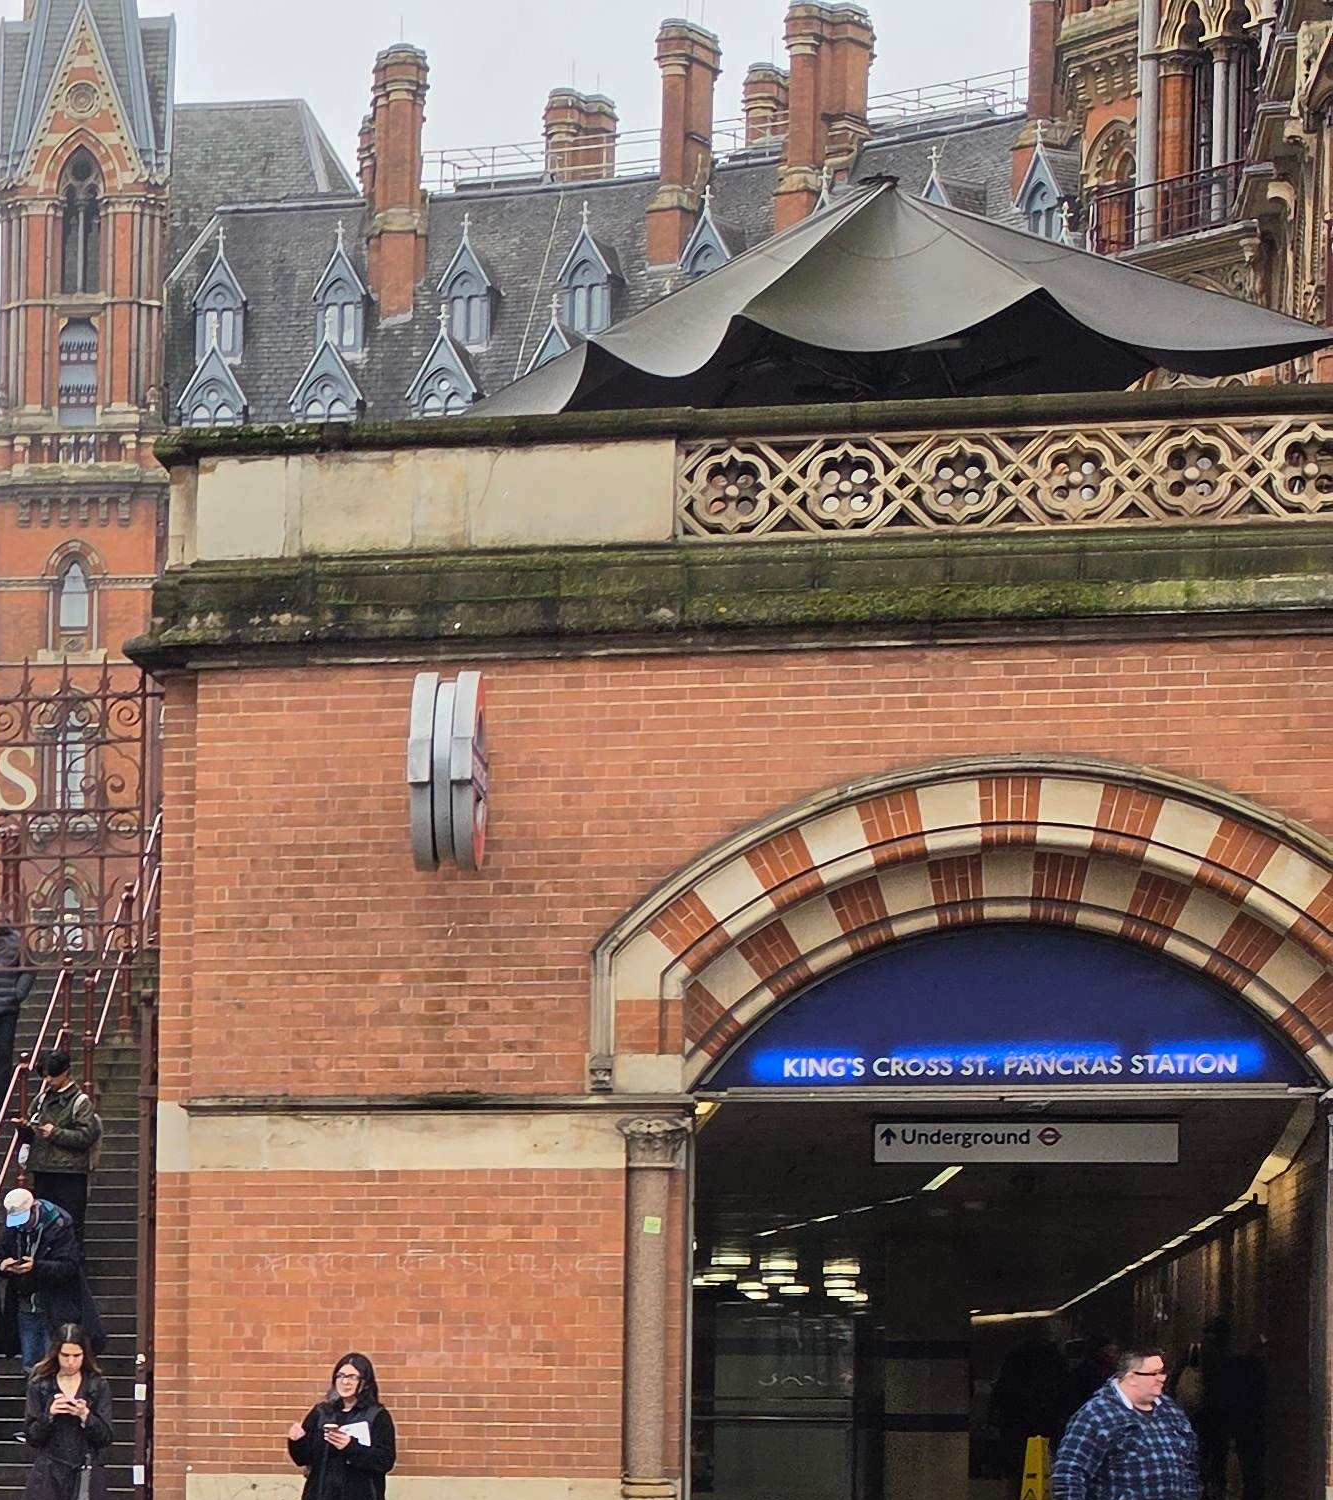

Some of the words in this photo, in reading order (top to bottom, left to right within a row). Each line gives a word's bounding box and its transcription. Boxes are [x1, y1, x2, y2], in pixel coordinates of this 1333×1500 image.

[783, 1057, 866, 1077] KING'S
[872, 1056, 954, 1077] CROSS
[960, 1055, 995, 1076] ST.
[1003, 1055, 1123, 1075] PANCRAS
[1130, 1053, 1237, 1074] STATION
[901, 1128, 1031, 1149] Underground
